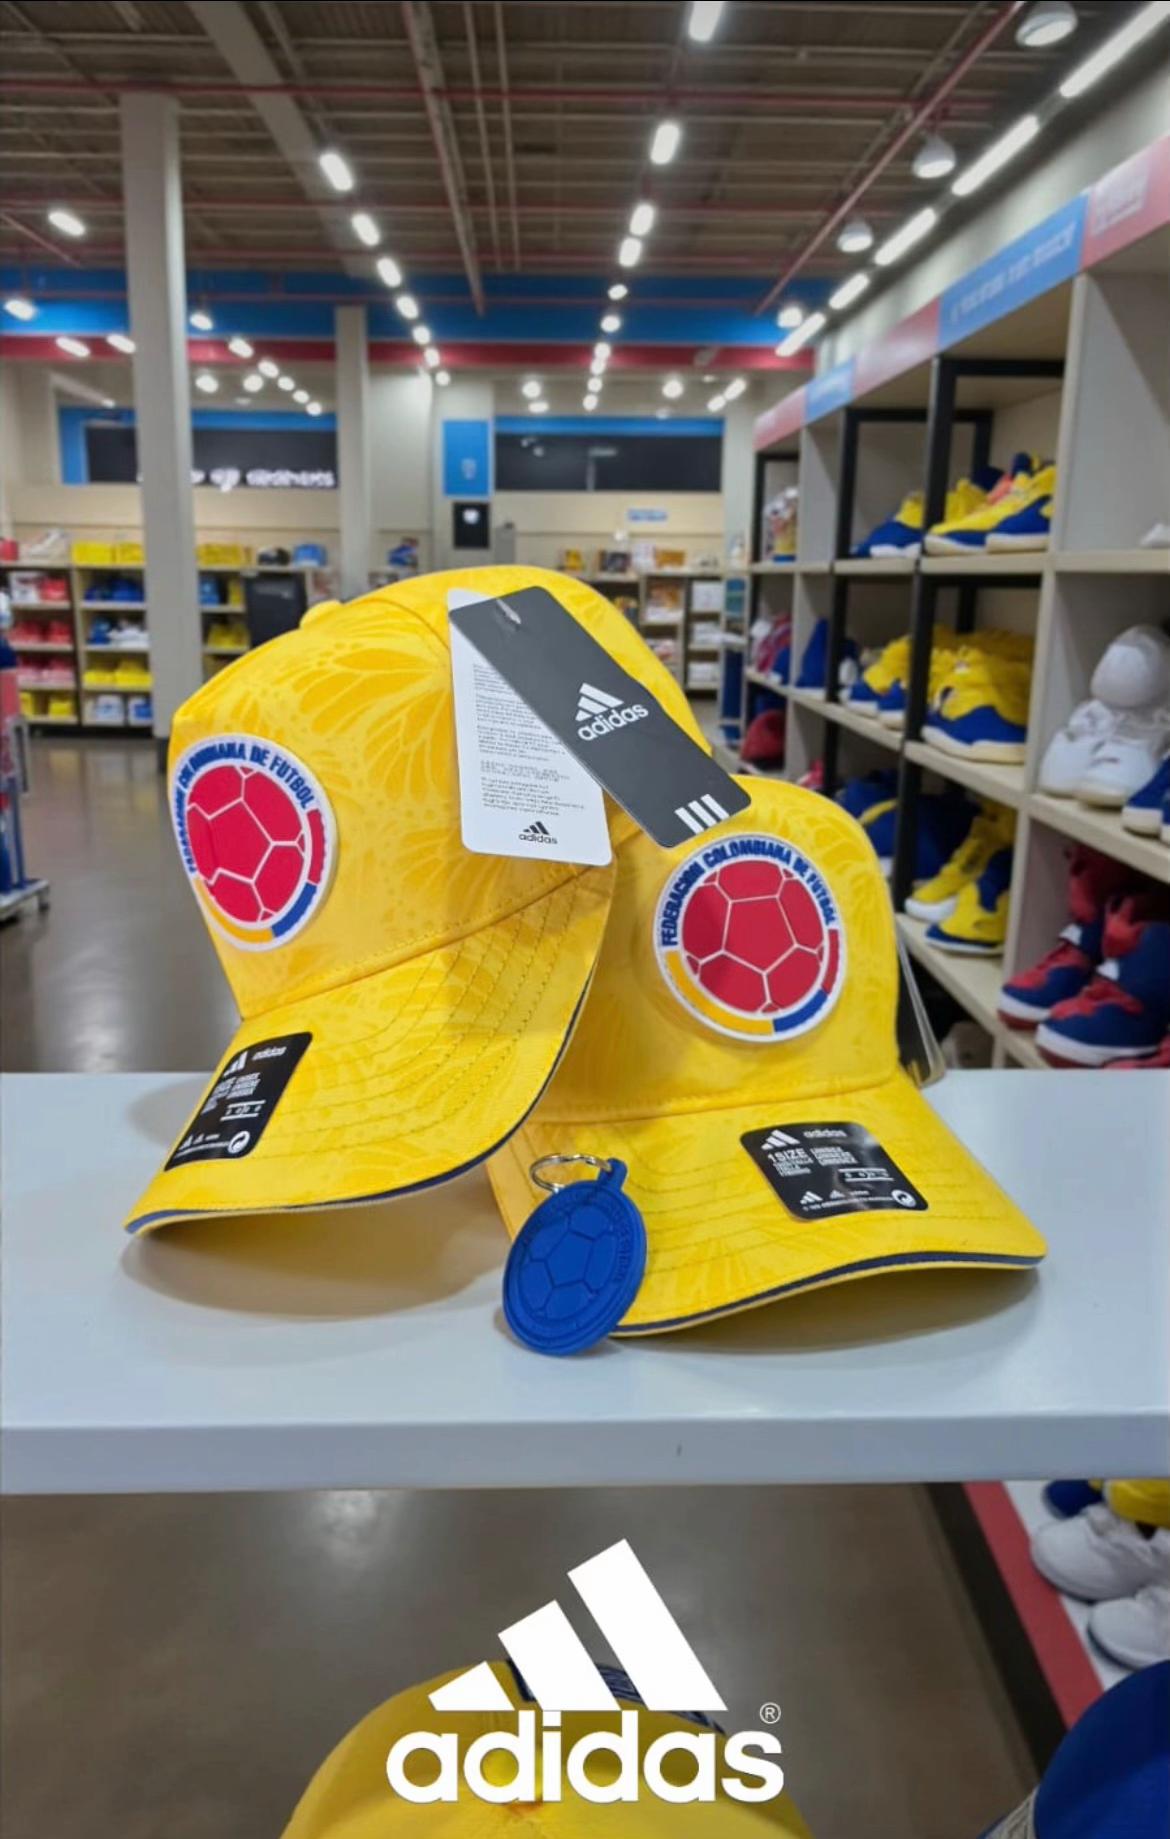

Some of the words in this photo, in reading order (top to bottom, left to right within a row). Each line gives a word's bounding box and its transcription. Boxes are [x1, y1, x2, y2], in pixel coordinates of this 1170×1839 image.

[577, 703, 649, 742] adidas
[249, 745, 269, 766] DE
[518, 833, 559, 845] adidas
[774, 1147, 809, 1161] SIZE
